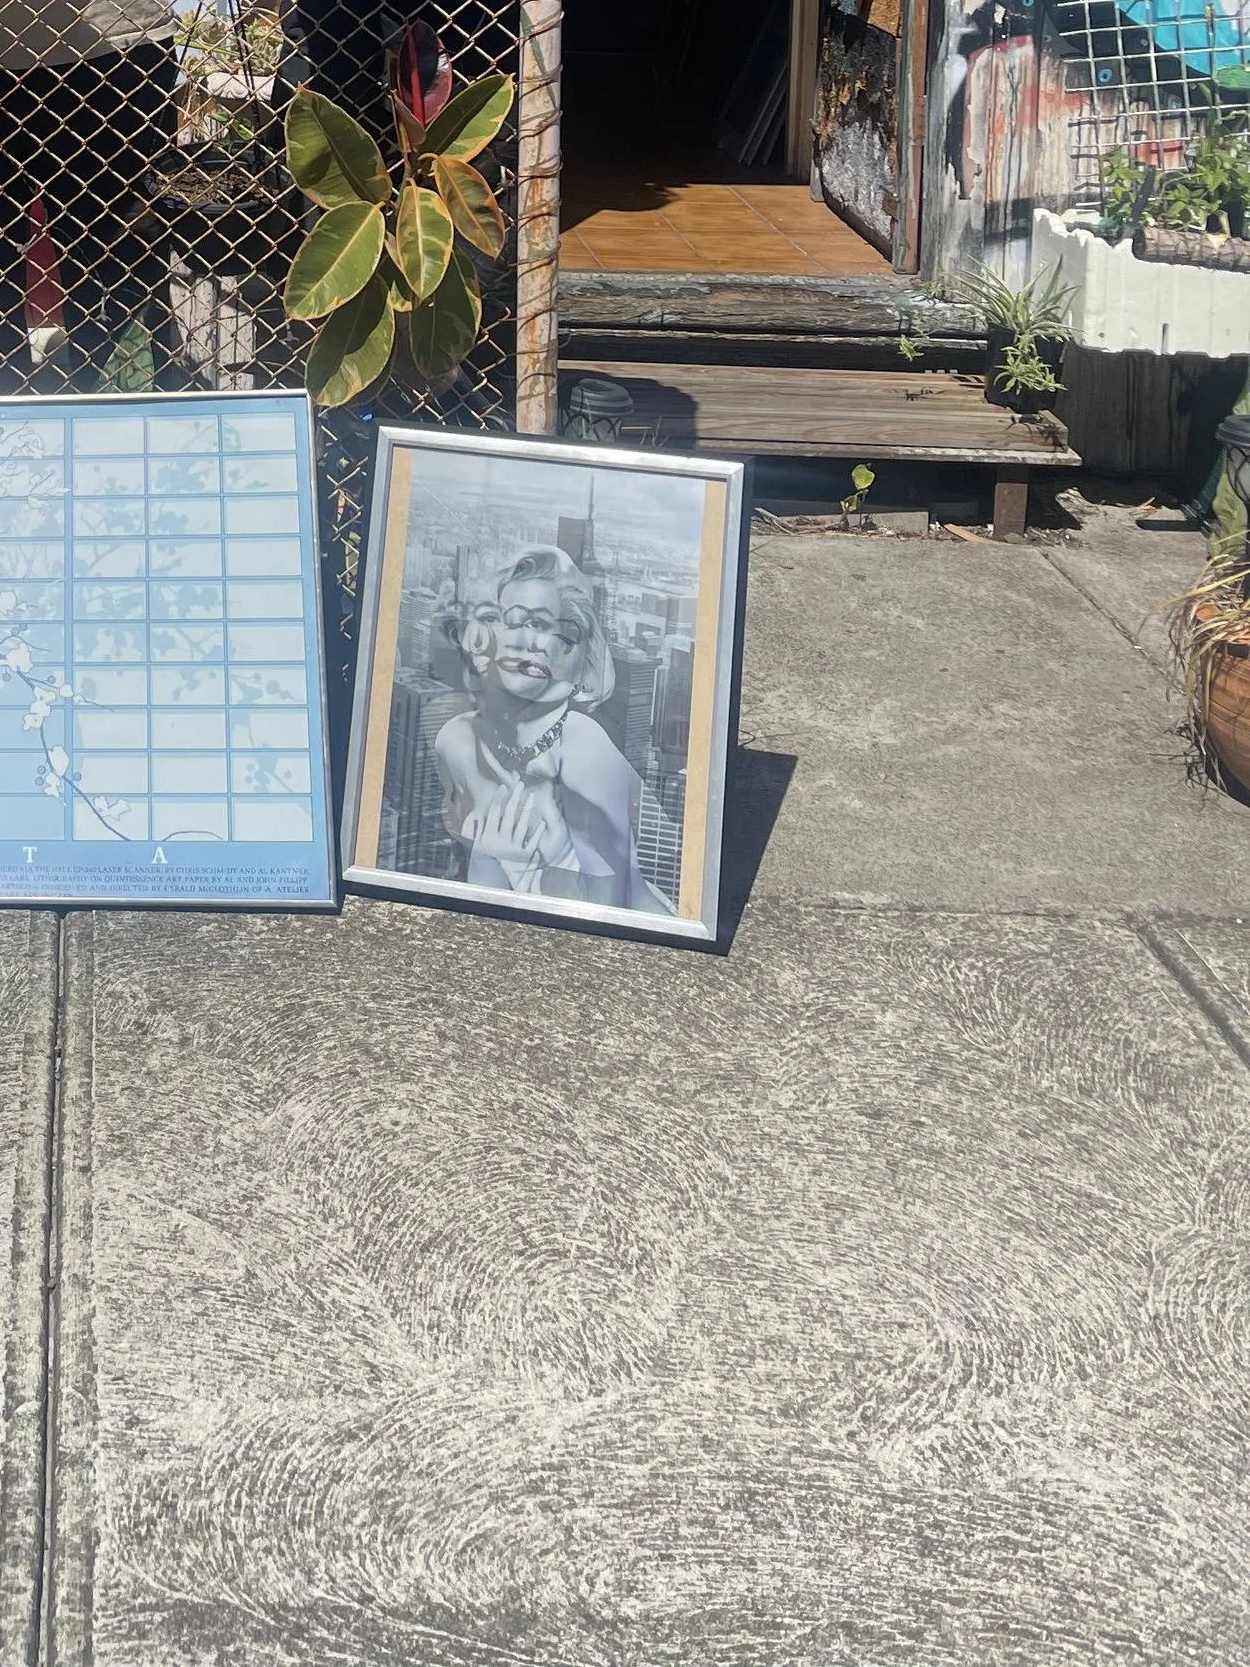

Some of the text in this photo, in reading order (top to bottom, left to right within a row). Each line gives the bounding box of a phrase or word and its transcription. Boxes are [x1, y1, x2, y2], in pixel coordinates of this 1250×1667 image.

[22, 845, 38, 863] T
[150, 845, 169, 864] A
[239, 867, 257, 875] AND
[33, 875, 88, 883] LITHOGRAPHY
[90, 875, 103, 883] ON
[104, 875, 164, 883] QUINTESSENCE
[224, 876, 234, 884] AL
[237, 876, 254, 884] AND
[256, 876, 277, 884] JOHN
[89, 884, 107, 892] AND
[109, 884, 149, 892] DIRECTED
[251, 885, 263, 893] OF
[276, 886, 310, 894] ATELIER
